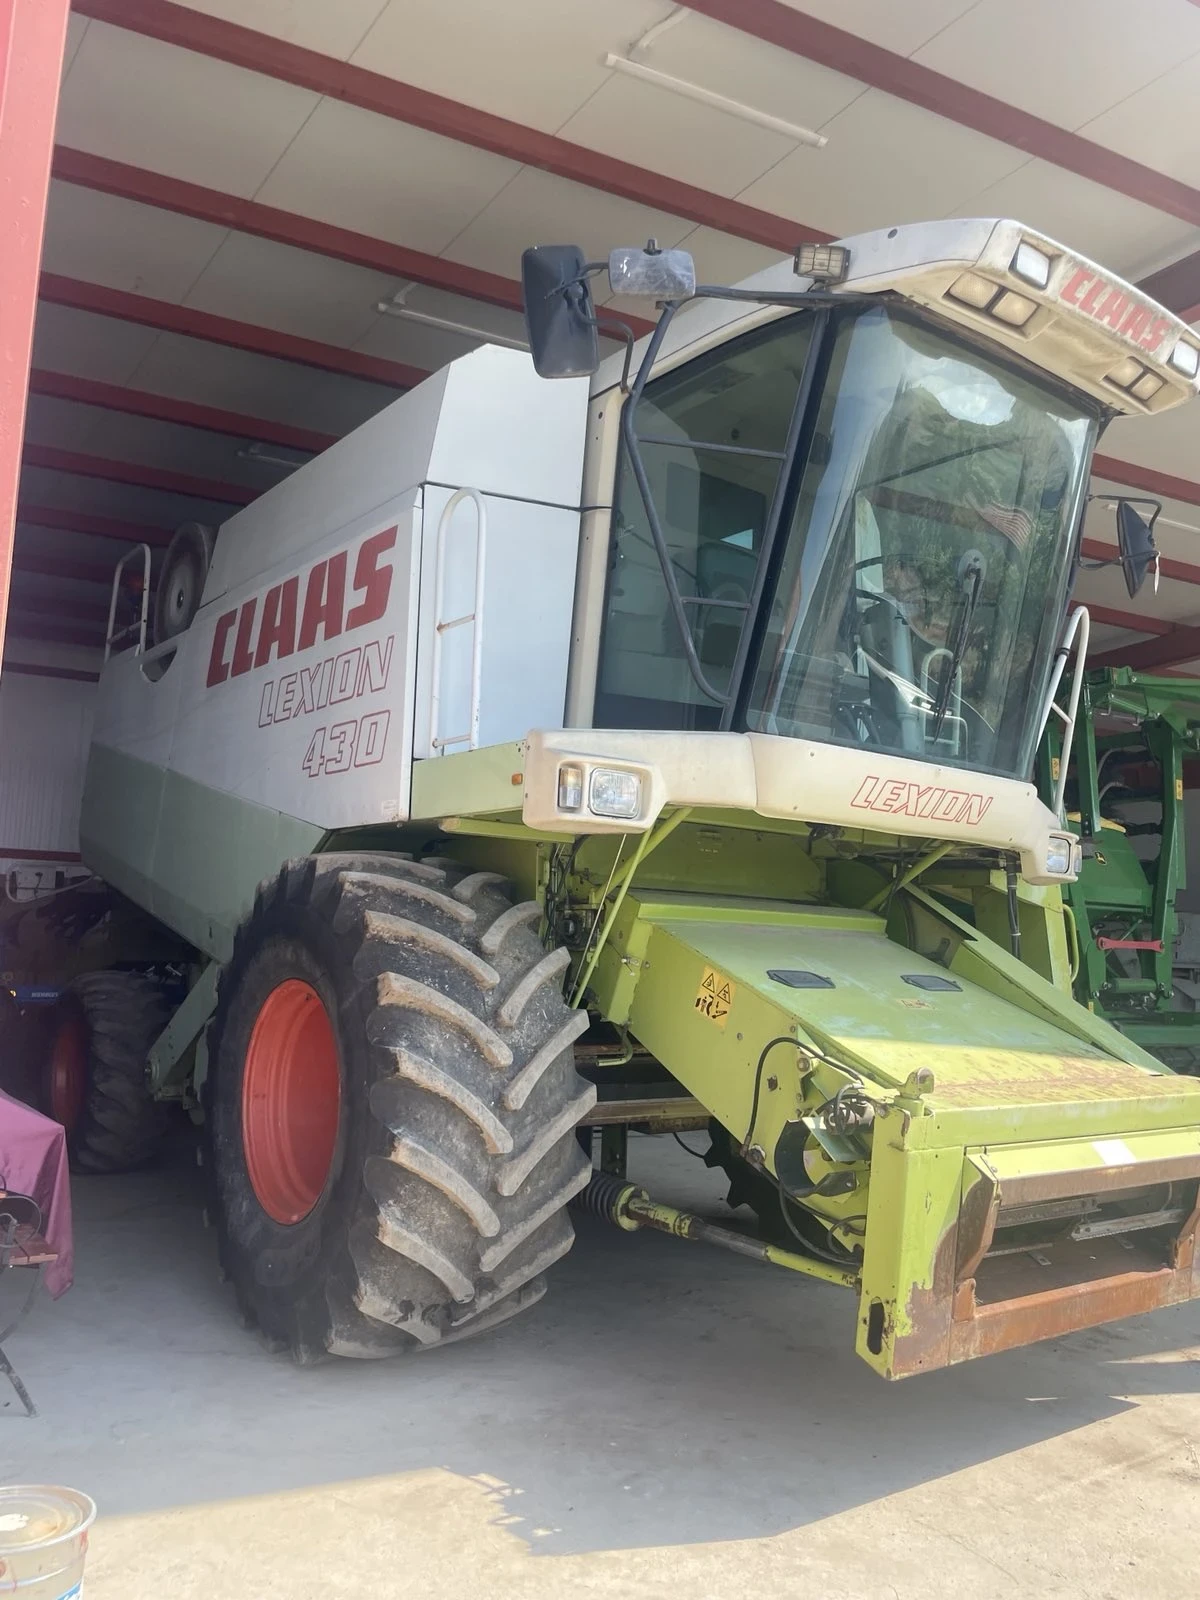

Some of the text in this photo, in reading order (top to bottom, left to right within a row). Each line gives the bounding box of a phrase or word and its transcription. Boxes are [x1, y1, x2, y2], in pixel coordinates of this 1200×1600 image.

[1060, 266, 1171, 352] CLAAS
[206, 524, 398, 688] CLAAS
[258, 635, 395, 728] LEXION
[302, 710, 391, 777] 430
[850, 776, 994, 825] LEXION
